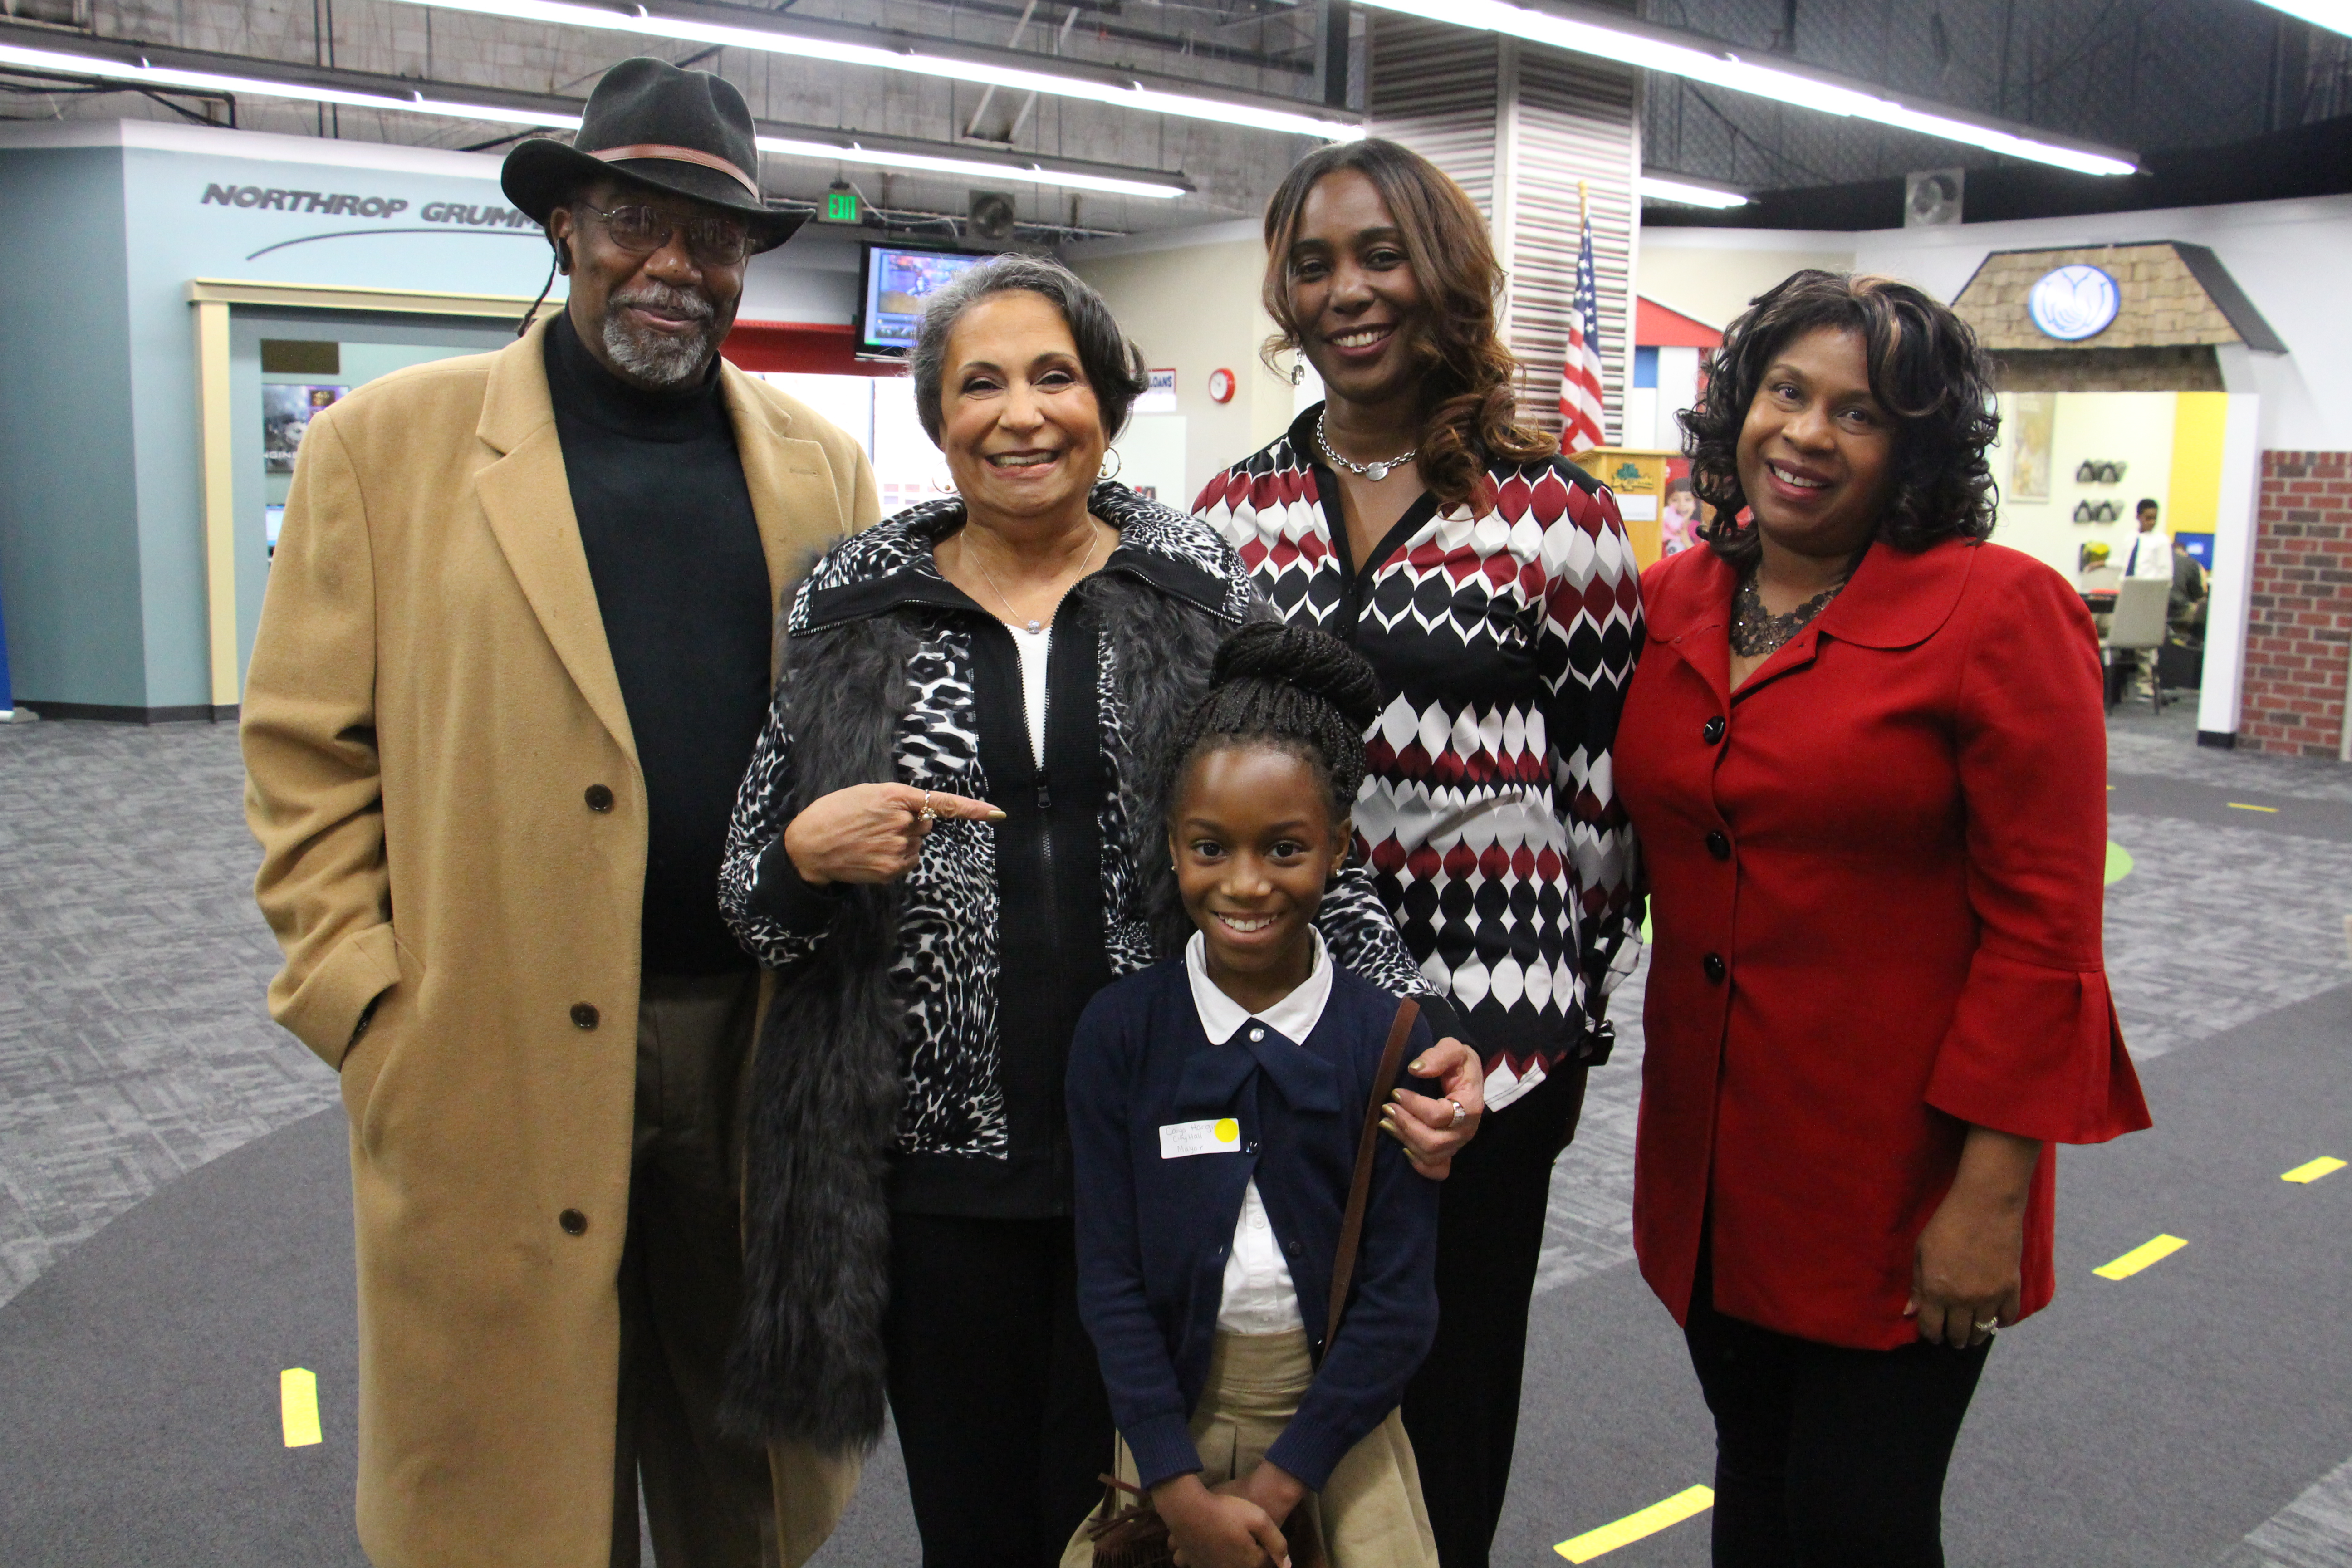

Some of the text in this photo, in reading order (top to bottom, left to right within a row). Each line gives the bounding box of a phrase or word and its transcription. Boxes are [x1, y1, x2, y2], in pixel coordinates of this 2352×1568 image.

[201, 183, 408, 219] NORTHROP
[828, 194, 857, 221] EXIT
[1177, 1145, 1203, 1154] Mayor
